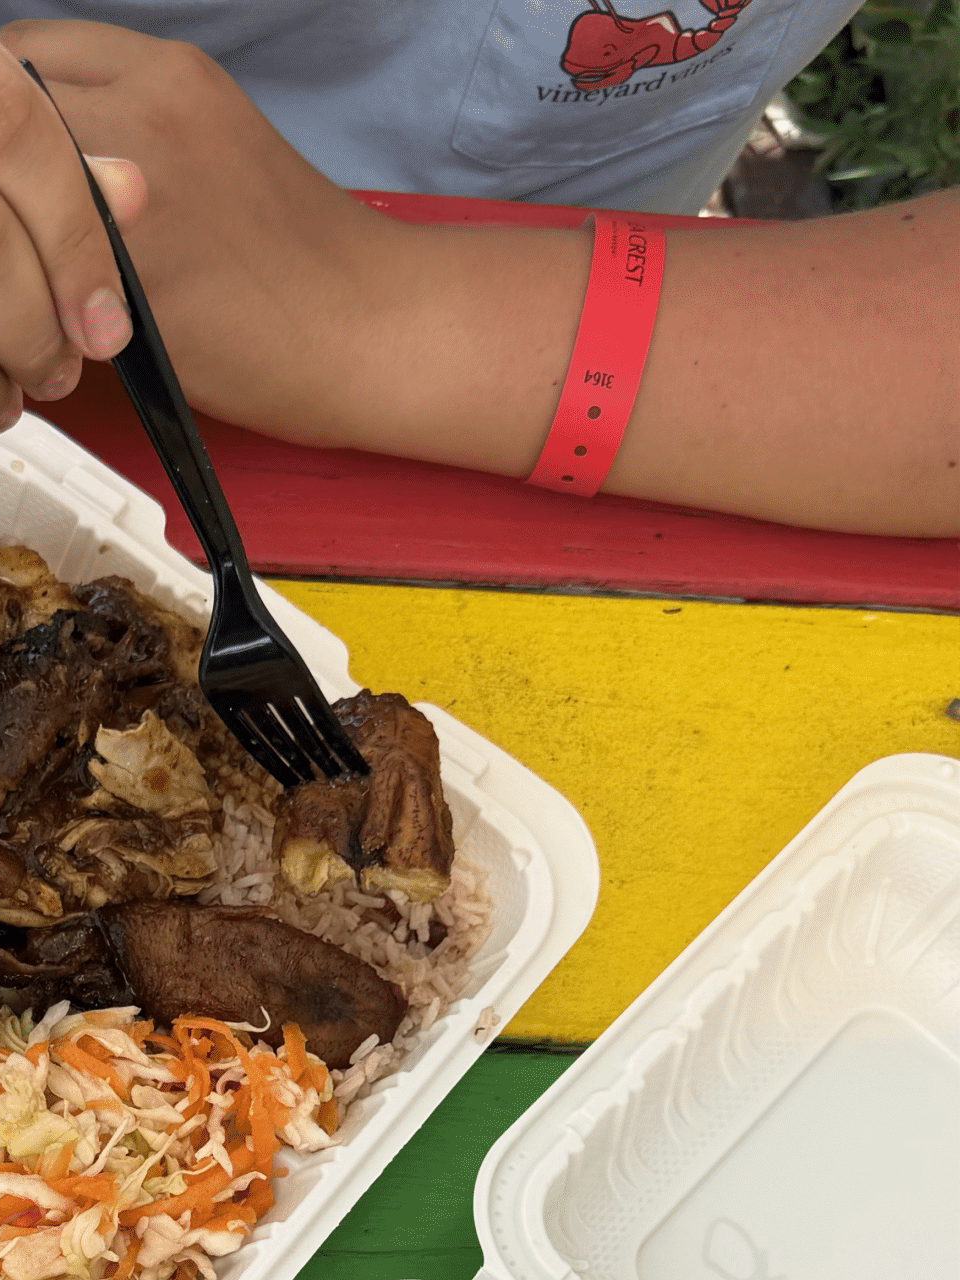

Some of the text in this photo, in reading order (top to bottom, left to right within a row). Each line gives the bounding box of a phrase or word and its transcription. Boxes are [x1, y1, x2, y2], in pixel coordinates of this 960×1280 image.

[536, 41, 737, 106] vineyard vines
[584, 370, 615, 389] 3164
